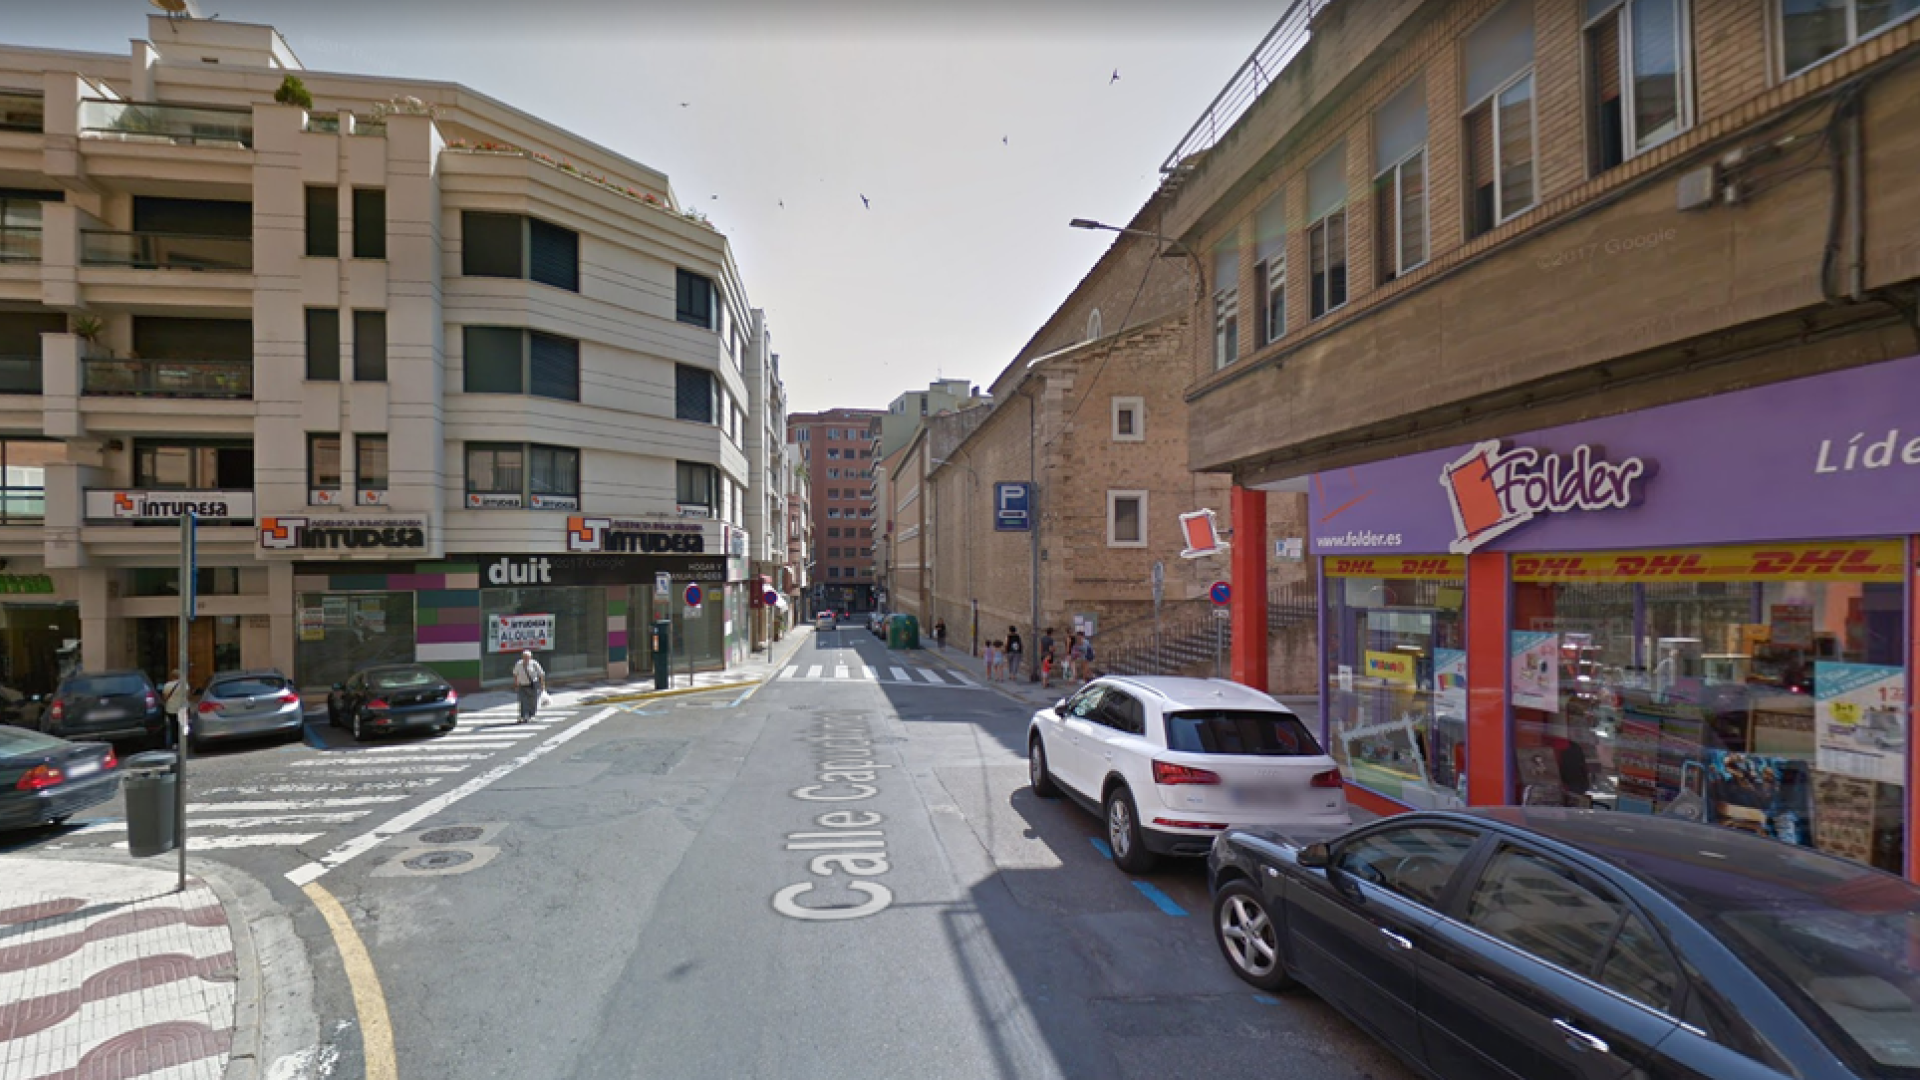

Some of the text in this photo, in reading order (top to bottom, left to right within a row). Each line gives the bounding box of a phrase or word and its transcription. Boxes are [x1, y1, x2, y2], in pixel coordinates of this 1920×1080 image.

[1482, 446, 1642, 513] Folder
[1001, 485, 1025, 509] P
[1316, 530, 1402, 547] www.folder.es
[488, 557, 552, 584] duit
[1337, 559, 1376, 573] DHL
[1401, 559, 1450, 574] DHL
[1515, 557, 1587, 576] DHL
[1614, 555, 1706, 575] DHL
[1750, 549, 1882, 574] DHL
